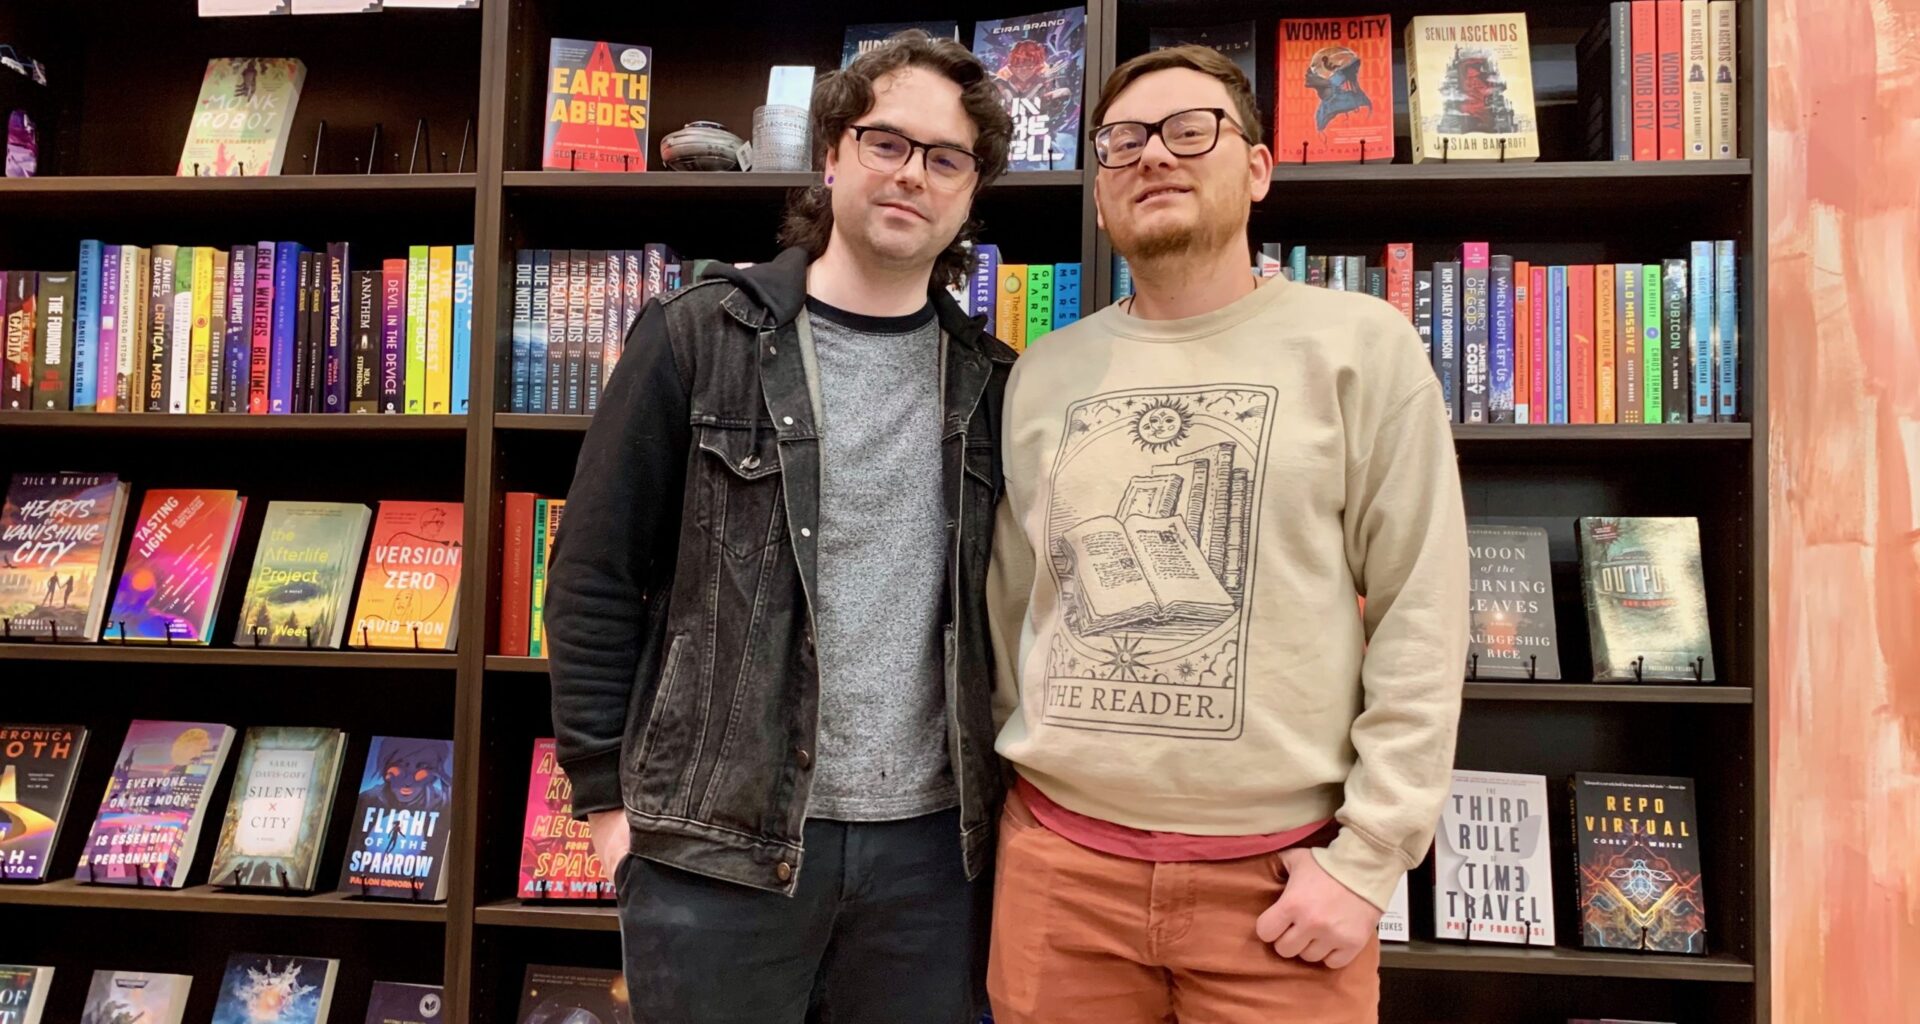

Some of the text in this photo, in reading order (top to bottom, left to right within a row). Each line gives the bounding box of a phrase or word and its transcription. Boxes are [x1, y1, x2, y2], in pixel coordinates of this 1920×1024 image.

[992, 18, 1066, 36] EIRA BRAND
[1285, 18, 1387, 41] WOMB CITY
[1425, 24, 1518, 42] SENLIN ASCENDS
[552, 67, 647, 101] EARTH
[1635, 52, 1653, 96] WOMB
[1661, 51, 1680, 96] WOMB
[196, 112, 276, 129] ROBOT
[551, 99, 646, 130] ABIDES
[1636, 100, 1653, 130] CITY
[1662, 99, 1680, 130] CITY
[1433, 136, 1527, 150] JSIAH BANROFT
[152, 256, 162, 298] SUAREZ
[161, 259, 171, 296] DANIEL
[440, 268, 453, 300] THE
[454, 260, 468, 304] END
[552, 264, 560, 277] THE
[608, 255, 620, 298] HEARTS
[648, 249, 661, 294] HEARTS
[1401, 268, 1410, 298] THESE
[1466, 277, 1477, 294] OF
[1625, 270, 1635, 299] WILD
[212, 281, 225, 318] SUNFORGE
[231, 250, 246, 324] THE GHOSTS TRAPPIST
[408, 256, 417, 317] PROBLEM
[515, 264, 531, 323] DUE NORTH
[1030, 272, 1039, 324] MARS
[1041, 270, 1049, 326] GREEN
[1059, 269, 1067, 320] MARS
[1069, 268, 1078, 319] BLUE
[48, 295, 64, 314] THE
[329, 256, 341, 348] Artificial Wisdom
[360, 276, 372, 329] ANATHEM
[415, 257, 428, 363] THE THREE-BODY
[427, 257, 441, 372] DARK FOREST
[550, 276, 568, 343] DEADLANDS
[568, 276, 587, 342] DEADLANDS
[588, 277, 606, 344] DEADLANDS
[1466, 296, 1477, 332] GODS
[1477, 278, 1486, 331] THE MERCY
[252, 248, 272, 395] BEN WINTERS BIG TIME
[1008, 296, 1020, 346] The Ministry
[1419, 281, 1431, 354] ALIEN
[1496, 276, 1508, 382] WHEN LIGHT LEFT US
[1625, 301, 1635, 354] MASSIVE
[8, 315, 23, 359] CADIA
[45, 316, 63, 365] FOUNDING
[76, 296, 88, 394] SKY DANIEL WILSON
[385, 279, 399, 395] DEVIL IN THE DEVICE
[1442, 268, 1454, 401] KIM STANLEY ROBINSON AURORA
[151, 303, 166, 399] CRITICAL MASS
[1478, 343, 1486, 373] JAMES
[1651, 348, 1660, 371] CHAOS
[230, 359, 238, 398] WAGERS
[356, 356, 364, 398] STEPHENSON
[363, 368, 371, 386] NEAL
[1466, 343, 1478, 395] COREY
[1651, 375, 1660, 409] TERMINAL
[23, 476, 99, 486] JILL DAVIES
[20, 499, 96, 520] HEARTS
[134, 496, 180, 542] TASTING
[2, 524, 100, 542] VANISHING
[139, 523, 174, 559] LIGHT
[270, 528, 296, 542] the
[13, 540, 77, 567] CITY
[265, 546, 330, 563] Afterlife
[375, 546, 461, 567] VERSION
[1469, 547, 1527, 560] MOON
[1480, 563, 1516, 573] of the
[258, 567, 320, 585] Project
[384, 571, 437, 590] ZERO
[1469, 580, 1547, 594] URNING
[246, 623, 268, 636] Tm
[357, 618, 401, 634] DAVID
[1487, 650, 1521, 660] RICE
[1049, 684, 1225, 720] THE READER.
[255, 770, 307, 779] DAVIS-GOFF
[269, 759, 298, 768] SARAH
[125, 776, 187, 790] EVERYONE
[249, 786, 307, 799] SILENT
[109, 794, 190, 809] ON THE MOON
[1452, 794, 1530, 823] THIRD
[1607, 795, 1664, 814] REPO
[250, 816, 291, 829] CITY
[362, 806, 440, 838] FLIGHT
[1585, 816, 1689, 837] VIRTUAL
[95, 833, 174, 846] IS ESSENTIAL
[364, 837, 428, 851] OF THE
[565, 841, 589, 850] FROM
[1459, 823, 1520, 853] RULE
[1593, 838, 1683, 849] COREY WHITE
[94, 852, 164, 866] PERSONNEL
[349, 850, 433, 878] SPARROW
[1465, 863, 1526, 892] TIME
[1446, 890, 1542, 924] TRAVEL
[1380, 921, 1403, 932] EUKES
[1446, 920, 1545, 936] PHIIP FRACASI
